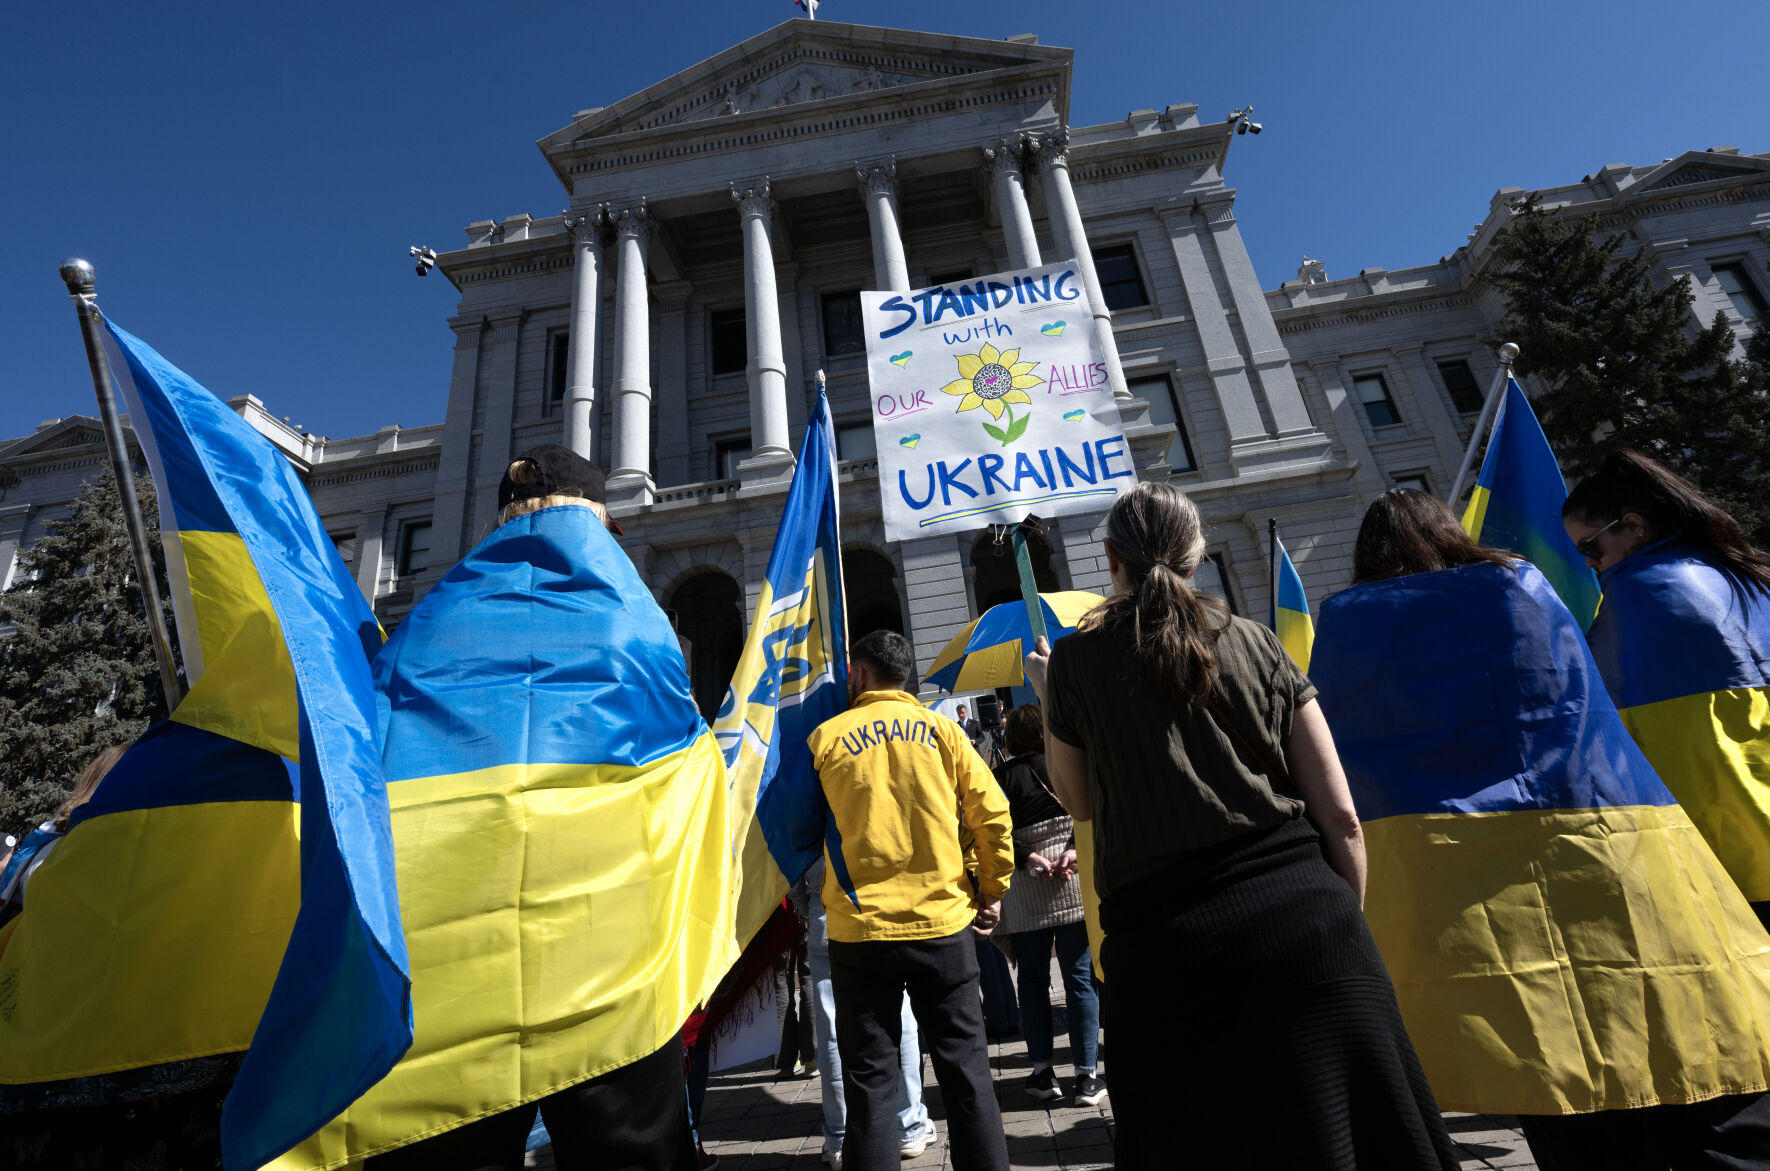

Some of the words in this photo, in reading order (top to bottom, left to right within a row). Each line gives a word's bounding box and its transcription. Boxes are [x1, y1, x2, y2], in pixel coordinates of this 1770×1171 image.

[879, 270, 1080, 339] STANDING
[943, 316, 1013, 345] with
[877, 389, 933, 416] OUR
[1048, 362, 1109, 394] ALLIES
[898, 435, 1133, 510] UKRAINE
